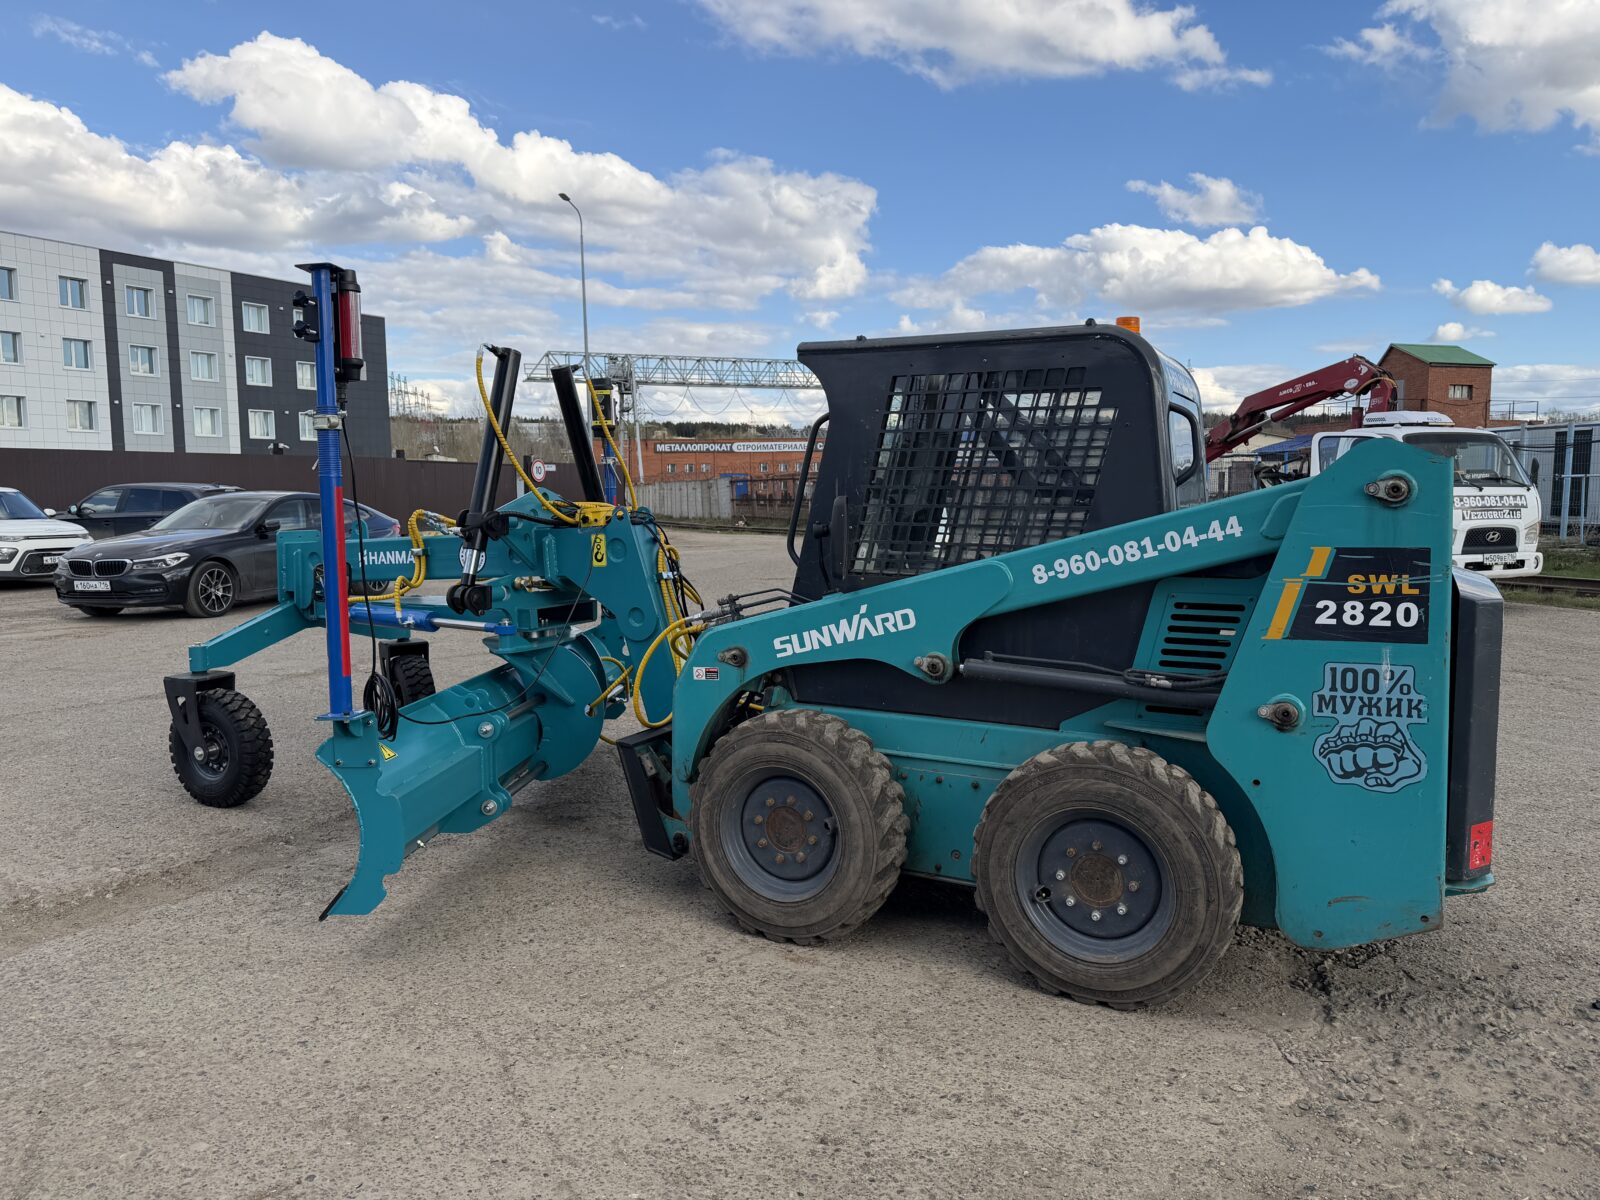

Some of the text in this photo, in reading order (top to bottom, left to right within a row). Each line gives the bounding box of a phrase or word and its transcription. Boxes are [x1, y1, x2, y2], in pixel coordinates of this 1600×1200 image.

[656, 443, 731, 452] МЕТАЛЛОПРОКАТ
[535, 466, 542, 475] 10
[1454, 495, 1526, 507] 8-960-081-04-44
[1032, 515, 1243, 584] 8-960-081-04-44
[1347, 574, 1420, 595] SWL
[1315, 600, 1419, 627] 2820
[773, 604, 917, 659] SUNWARD
[1329, 667, 1411, 695] 100%
[1317, 694, 1424, 718] МУЖИК
